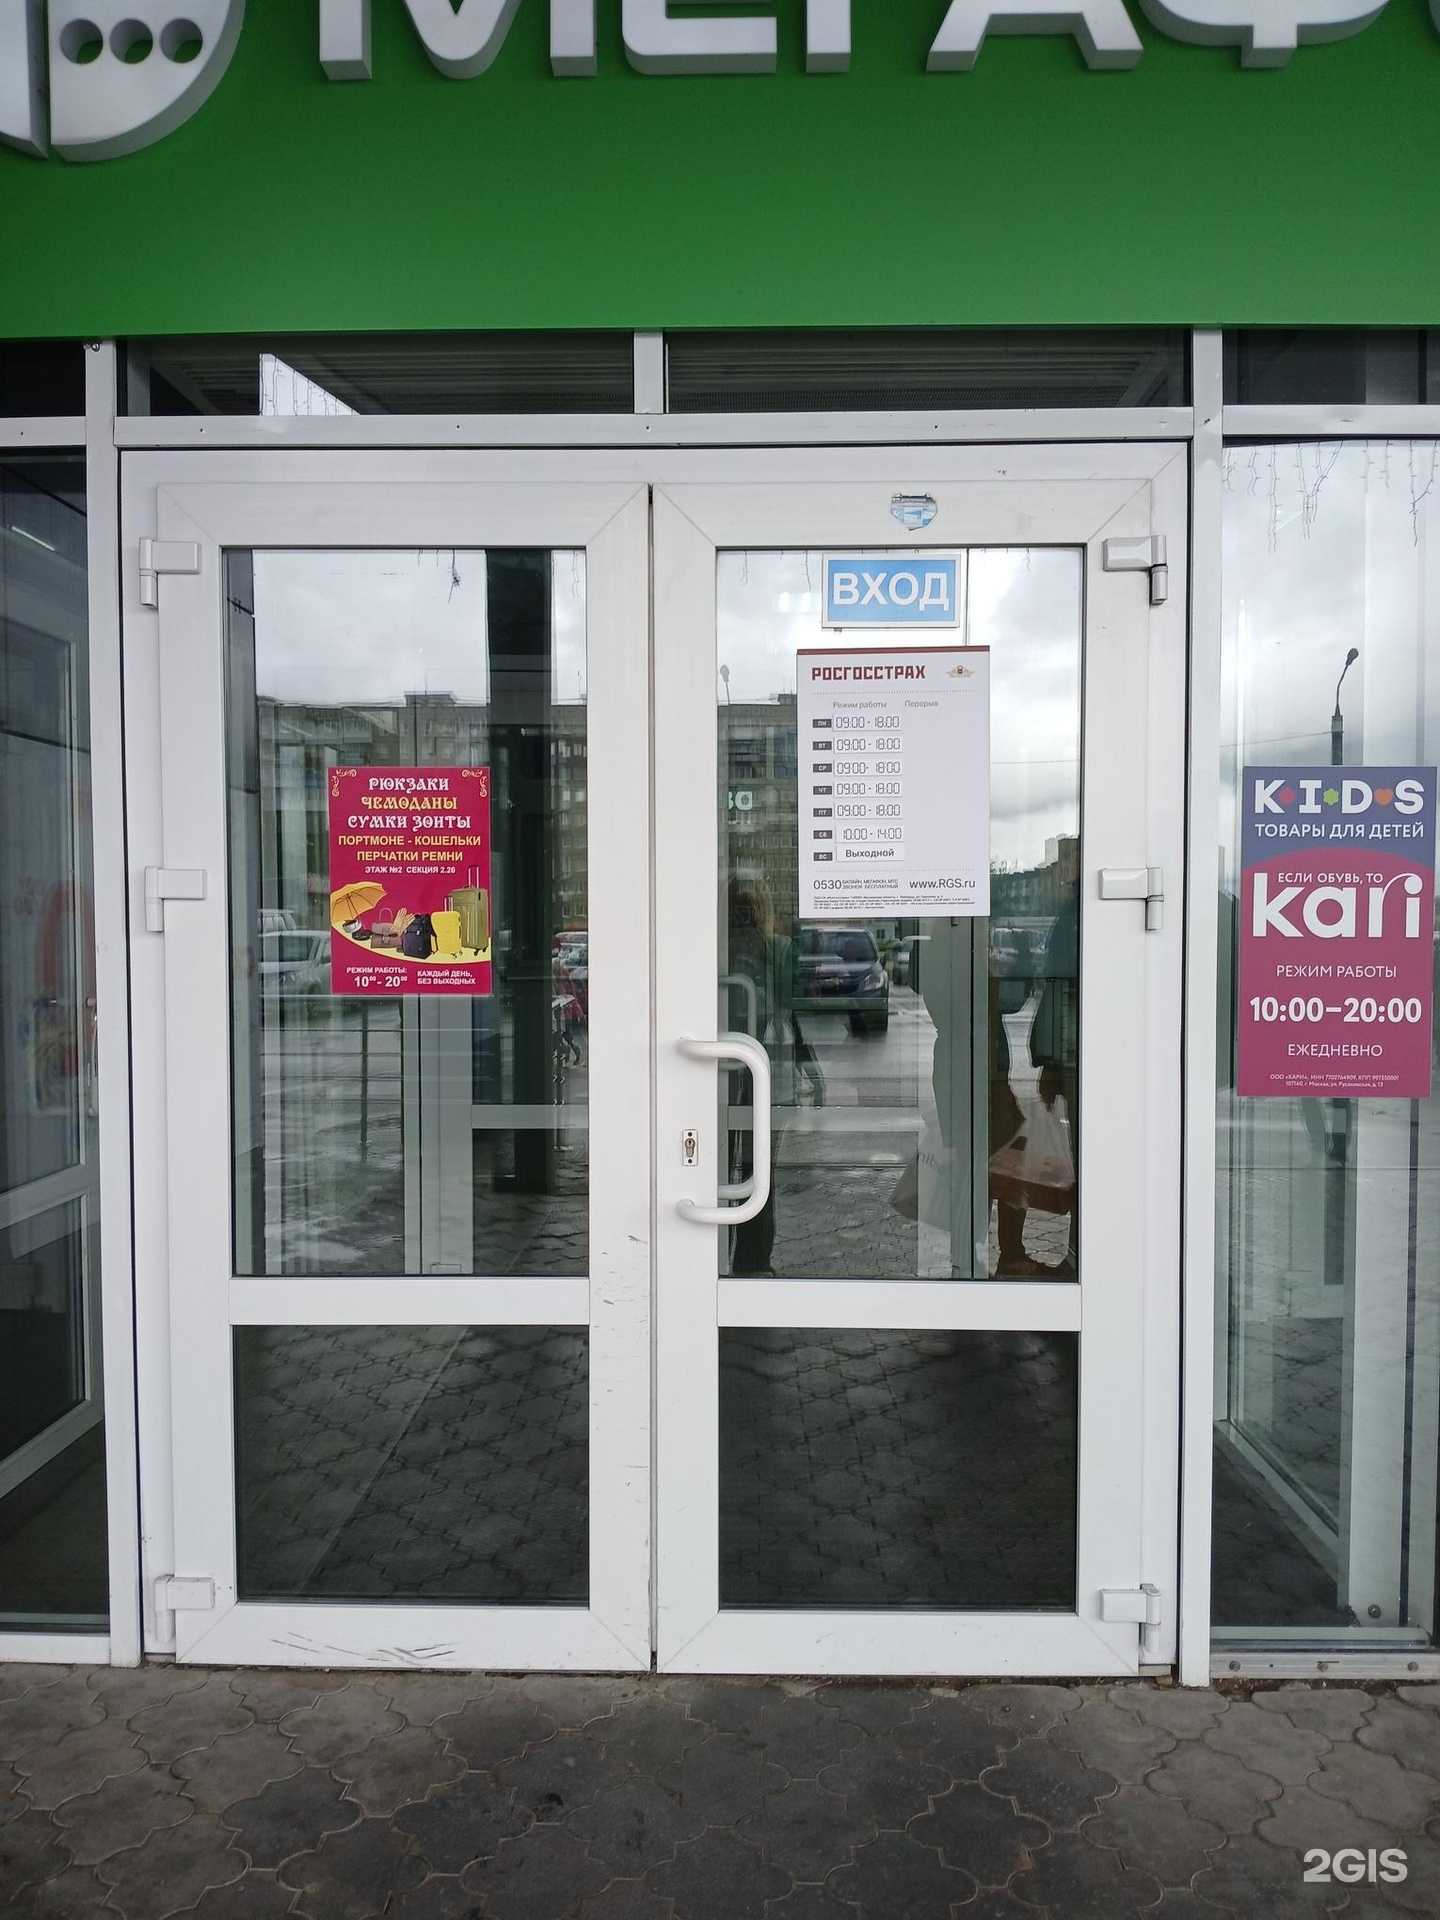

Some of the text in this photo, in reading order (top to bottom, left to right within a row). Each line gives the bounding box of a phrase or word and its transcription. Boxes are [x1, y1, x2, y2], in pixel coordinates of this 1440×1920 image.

[833, 572, 950, 611] ВХОД
[811, 665, 926, 681] РОСГОССТРАХ
[859, 701, 888, 710] работы
[369, 777, 450, 794] РЮКЗАКИ
[361, 796, 457, 811] ЧЕМОДАНЫ
[347, 815, 471, 832] СУМКИ ЗОНТЫ
[1254, 821, 1424, 840] ТОВАРЫ ДЛЯ ДЕТЕЙ
[338, 835, 404, 846] ПОРТМОНЕ
[414, 835, 481, 846] КОШЕЛЬКИ
[357, 851, 463, 862] ПЕРЧАТКИ РЕМНИ
[845, 847, 896, 858] Выходной
[365, 866, 388, 874] ЭТАЖ
[406, 866, 439, 875] СЕКЦИЯ
[813, 879, 842, 889] 0530
[909, 878, 976, 889] www.RGS.ru
[1278, 872, 1384, 885] ЕСЛИ ОБУВЬ, ТО
[1252, 872, 1423, 938] kari
[417, 970, 449, 978] КАЖДЫЙ
[1276, 965, 1398, 978] РЕЖИМ РАБОТЫ
[1288, 1044, 1383, 1057] ЕЖЕДНЕВНО
